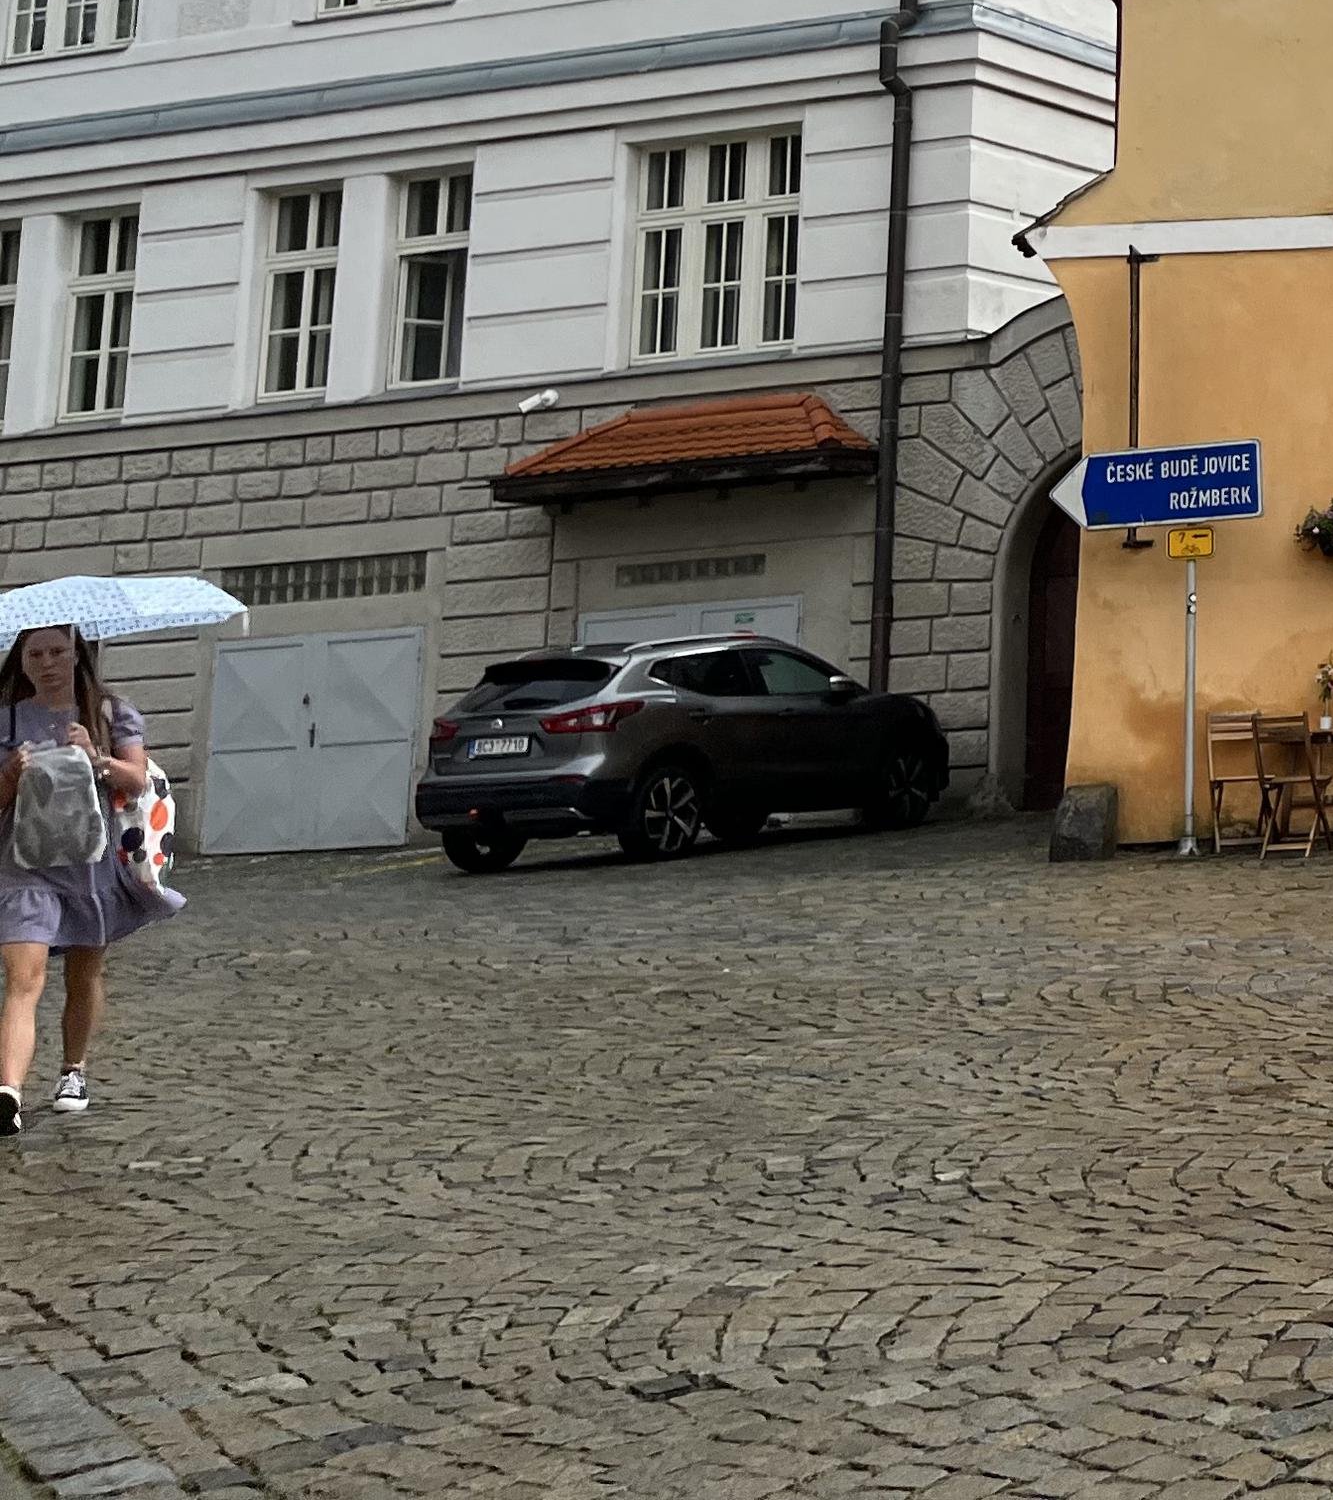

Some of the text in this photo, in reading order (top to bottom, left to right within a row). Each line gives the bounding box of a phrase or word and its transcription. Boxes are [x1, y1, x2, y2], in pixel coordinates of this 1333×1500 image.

[1106, 453, 1251, 483] ČESKÉ BUDĚJOVICE
[1169, 485, 1252, 510] ROŽMBERK
